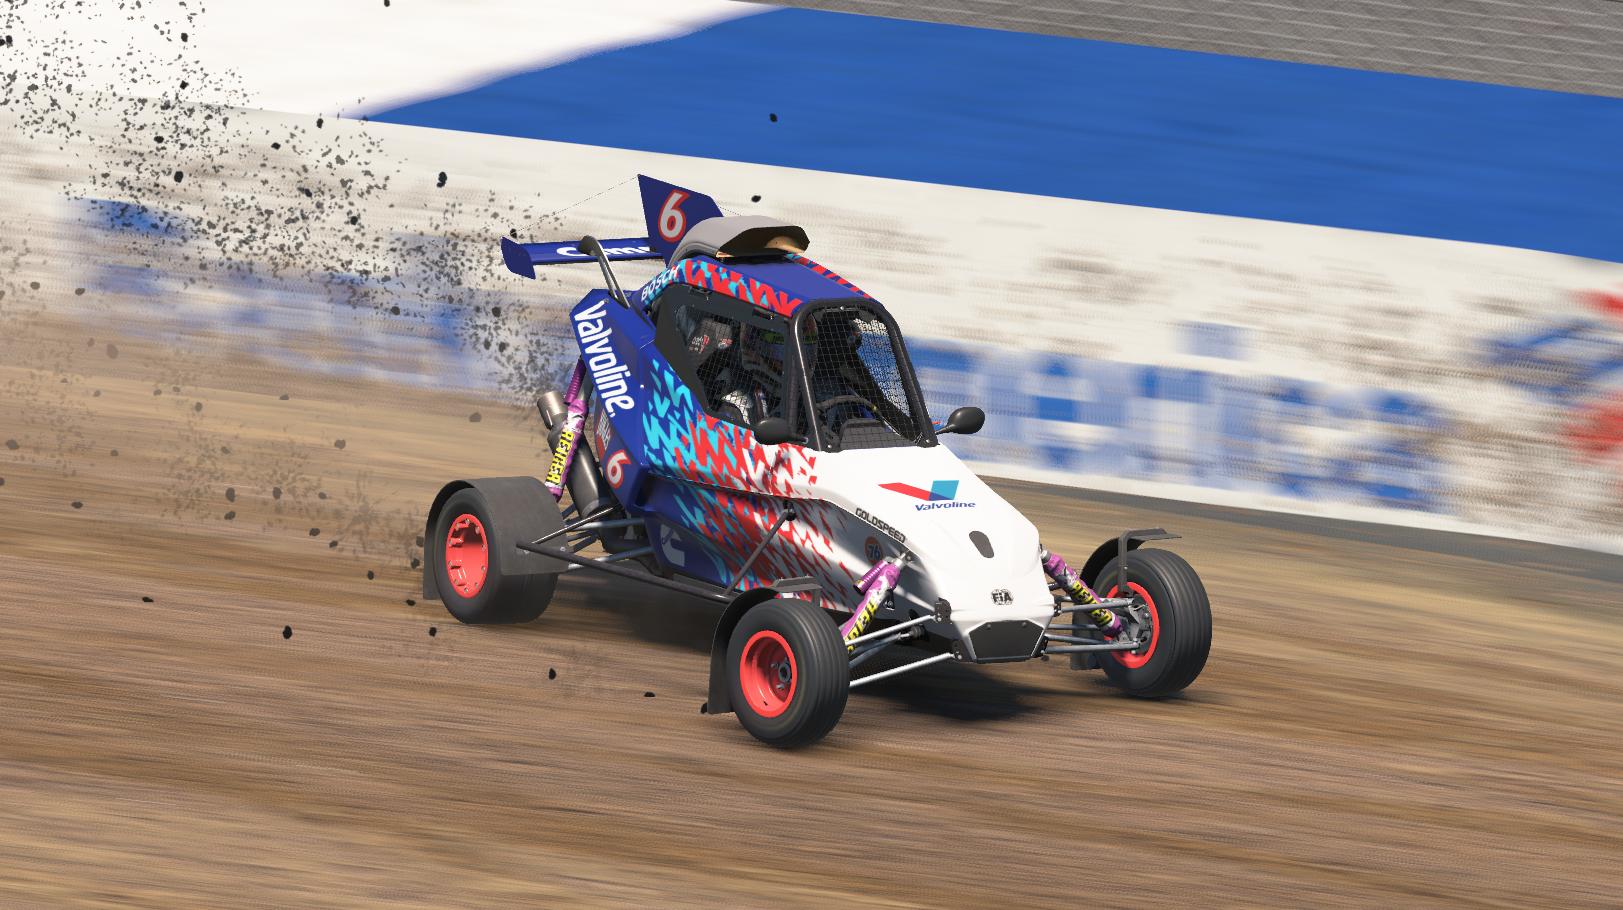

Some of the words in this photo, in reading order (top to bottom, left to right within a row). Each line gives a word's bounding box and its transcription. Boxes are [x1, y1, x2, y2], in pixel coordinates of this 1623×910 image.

[658, 189, 689, 242] 6
[641, 265, 680, 301] BOSCH
[606, 450, 632, 489] 6
[915, 501, 976, 511] Valvoline
[855, 507, 906, 543] GOLDSPEED
